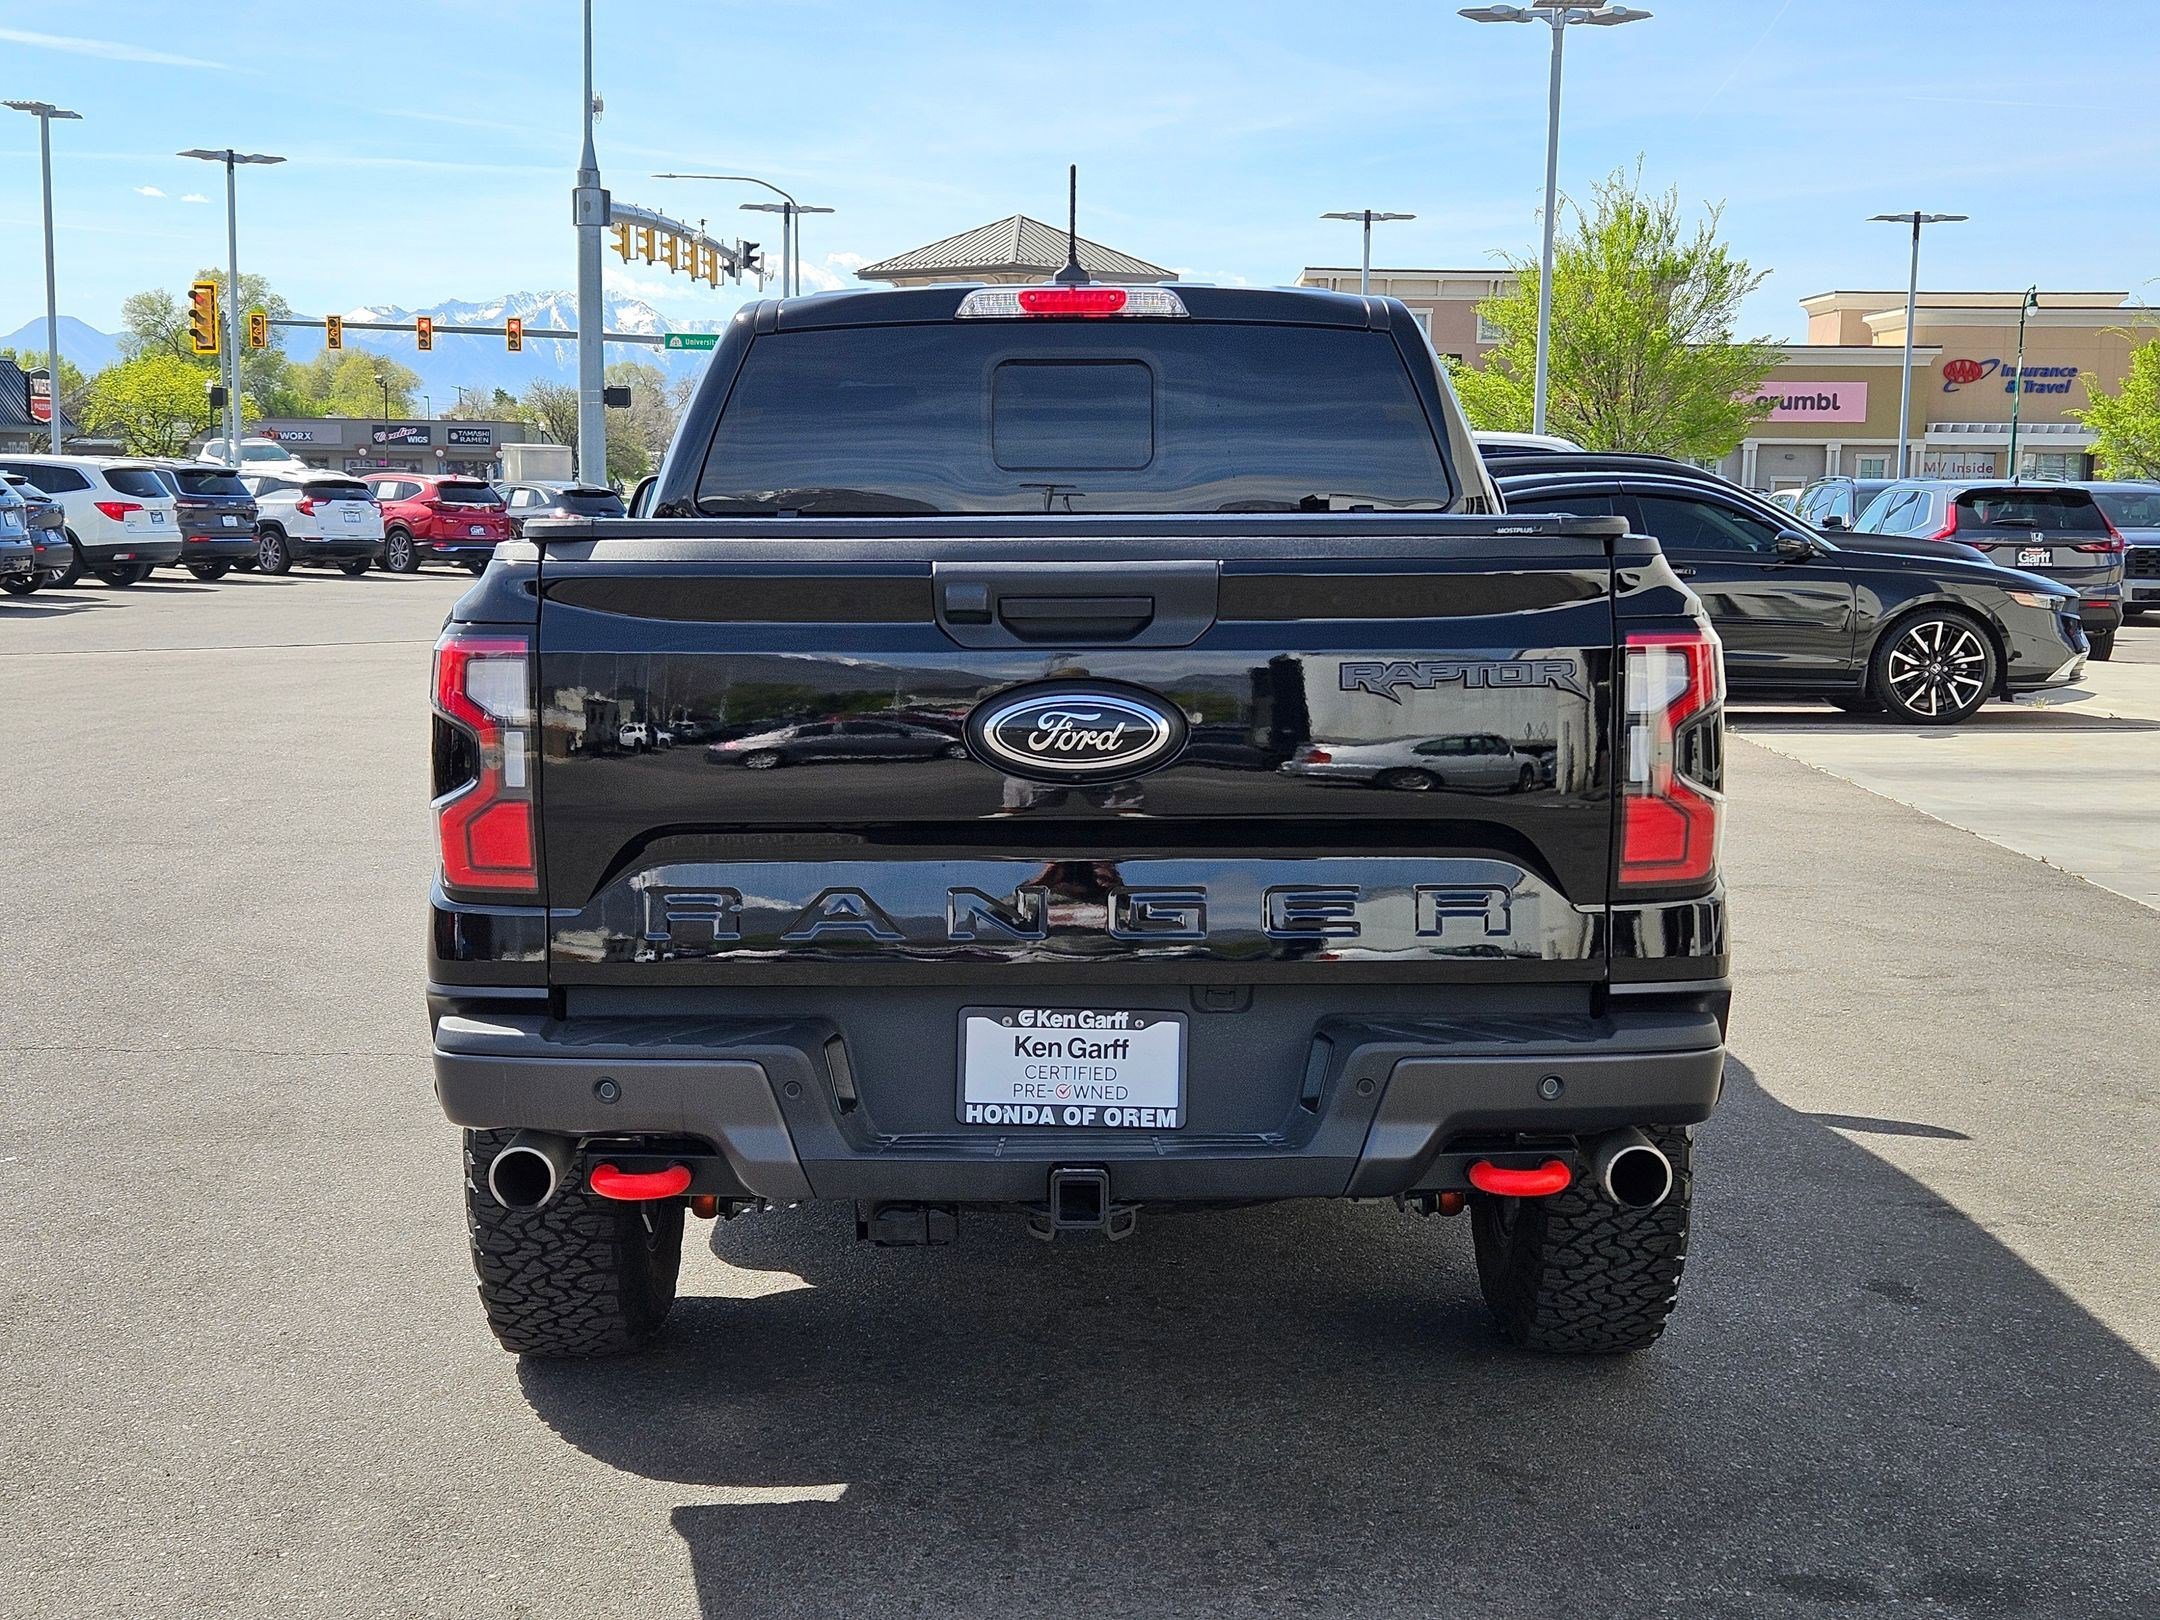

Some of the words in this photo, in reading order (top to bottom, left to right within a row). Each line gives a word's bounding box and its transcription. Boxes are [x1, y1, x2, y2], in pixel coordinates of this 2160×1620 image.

[2001, 364, 2078, 377] Inurance
[2023, 380, 2072, 393] Travel
[373, 427, 417, 442] Ceative
[1952, 462, 1994, 473] Inside
[2018, 551, 2050, 563] Garff
[1340, 659, 1591, 705] RAPTOR
[1028, 711, 1125, 751] Ford
[643, 885, 1511, 941] RANGER
[1037, 1010, 1075, 1028] Ken
[1078, 1011, 1129, 1029] Garff
[1014, 1035, 1062, 1057] Ken
[1067, 1037, 1129, 1060] Garff
[1025, 1065, 1117, 1081] CERTIFIED
[965, 1104, 1055, 1126] HONDA
[1063, 1106, 1096, 1126] OF
[1103, 1108, 1177, 1128] OREM
